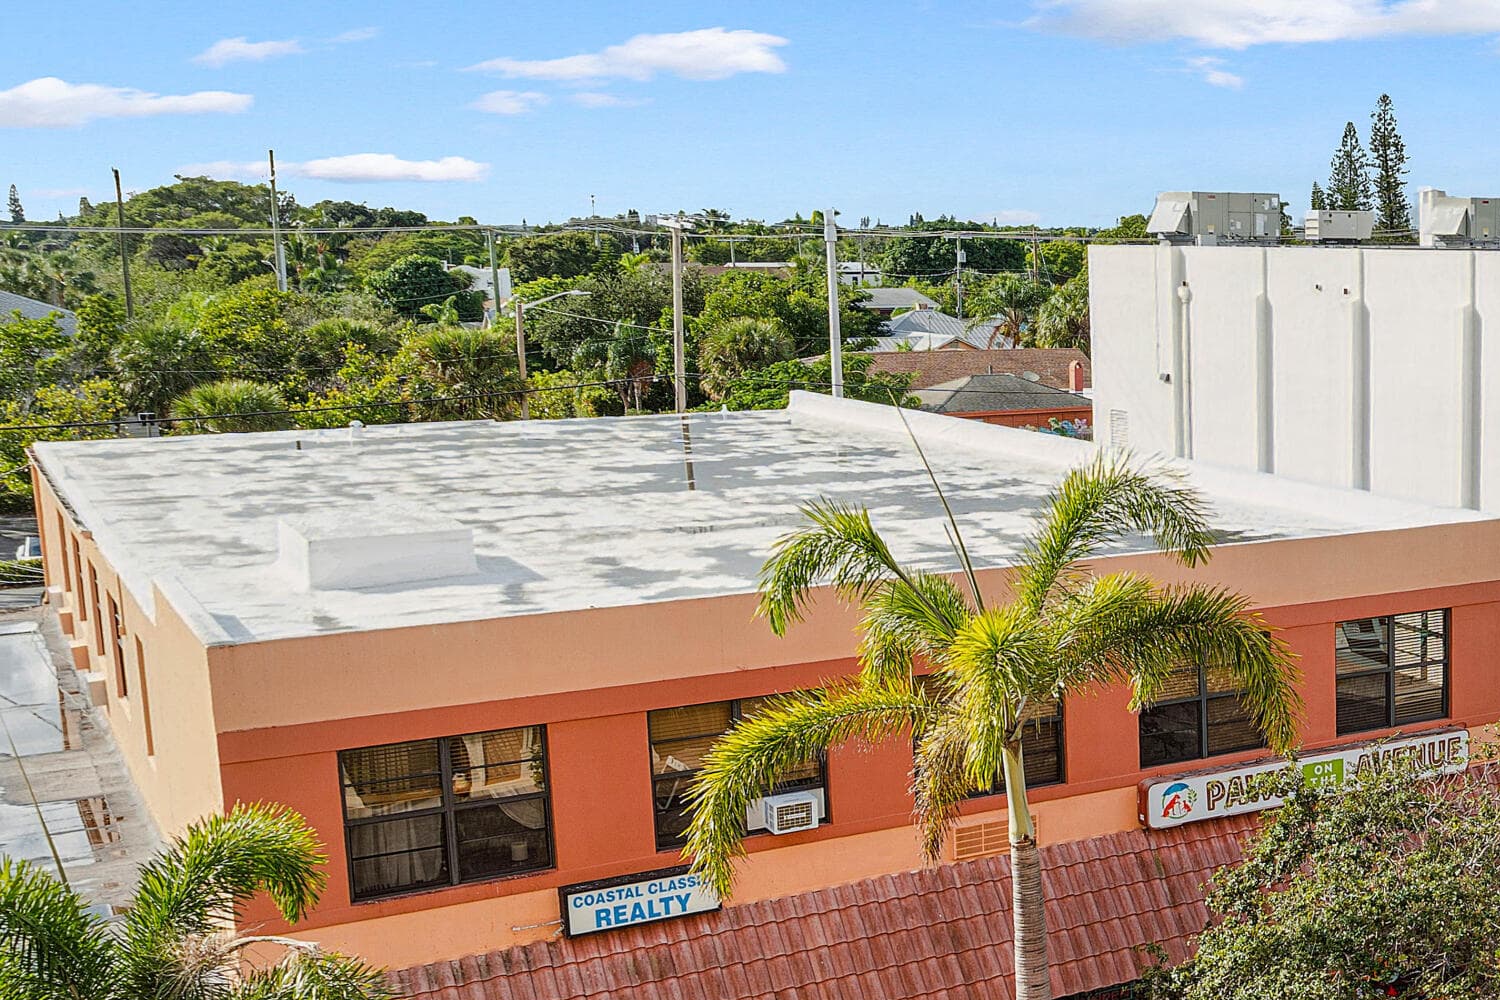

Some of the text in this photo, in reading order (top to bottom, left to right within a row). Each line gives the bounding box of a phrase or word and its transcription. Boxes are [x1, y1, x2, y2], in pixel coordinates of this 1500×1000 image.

[1314, 763, 1333, 775] ON
[573, 875, 708, 908] COASTAL CLASS
[595, 892, 691, 928] REALTY
